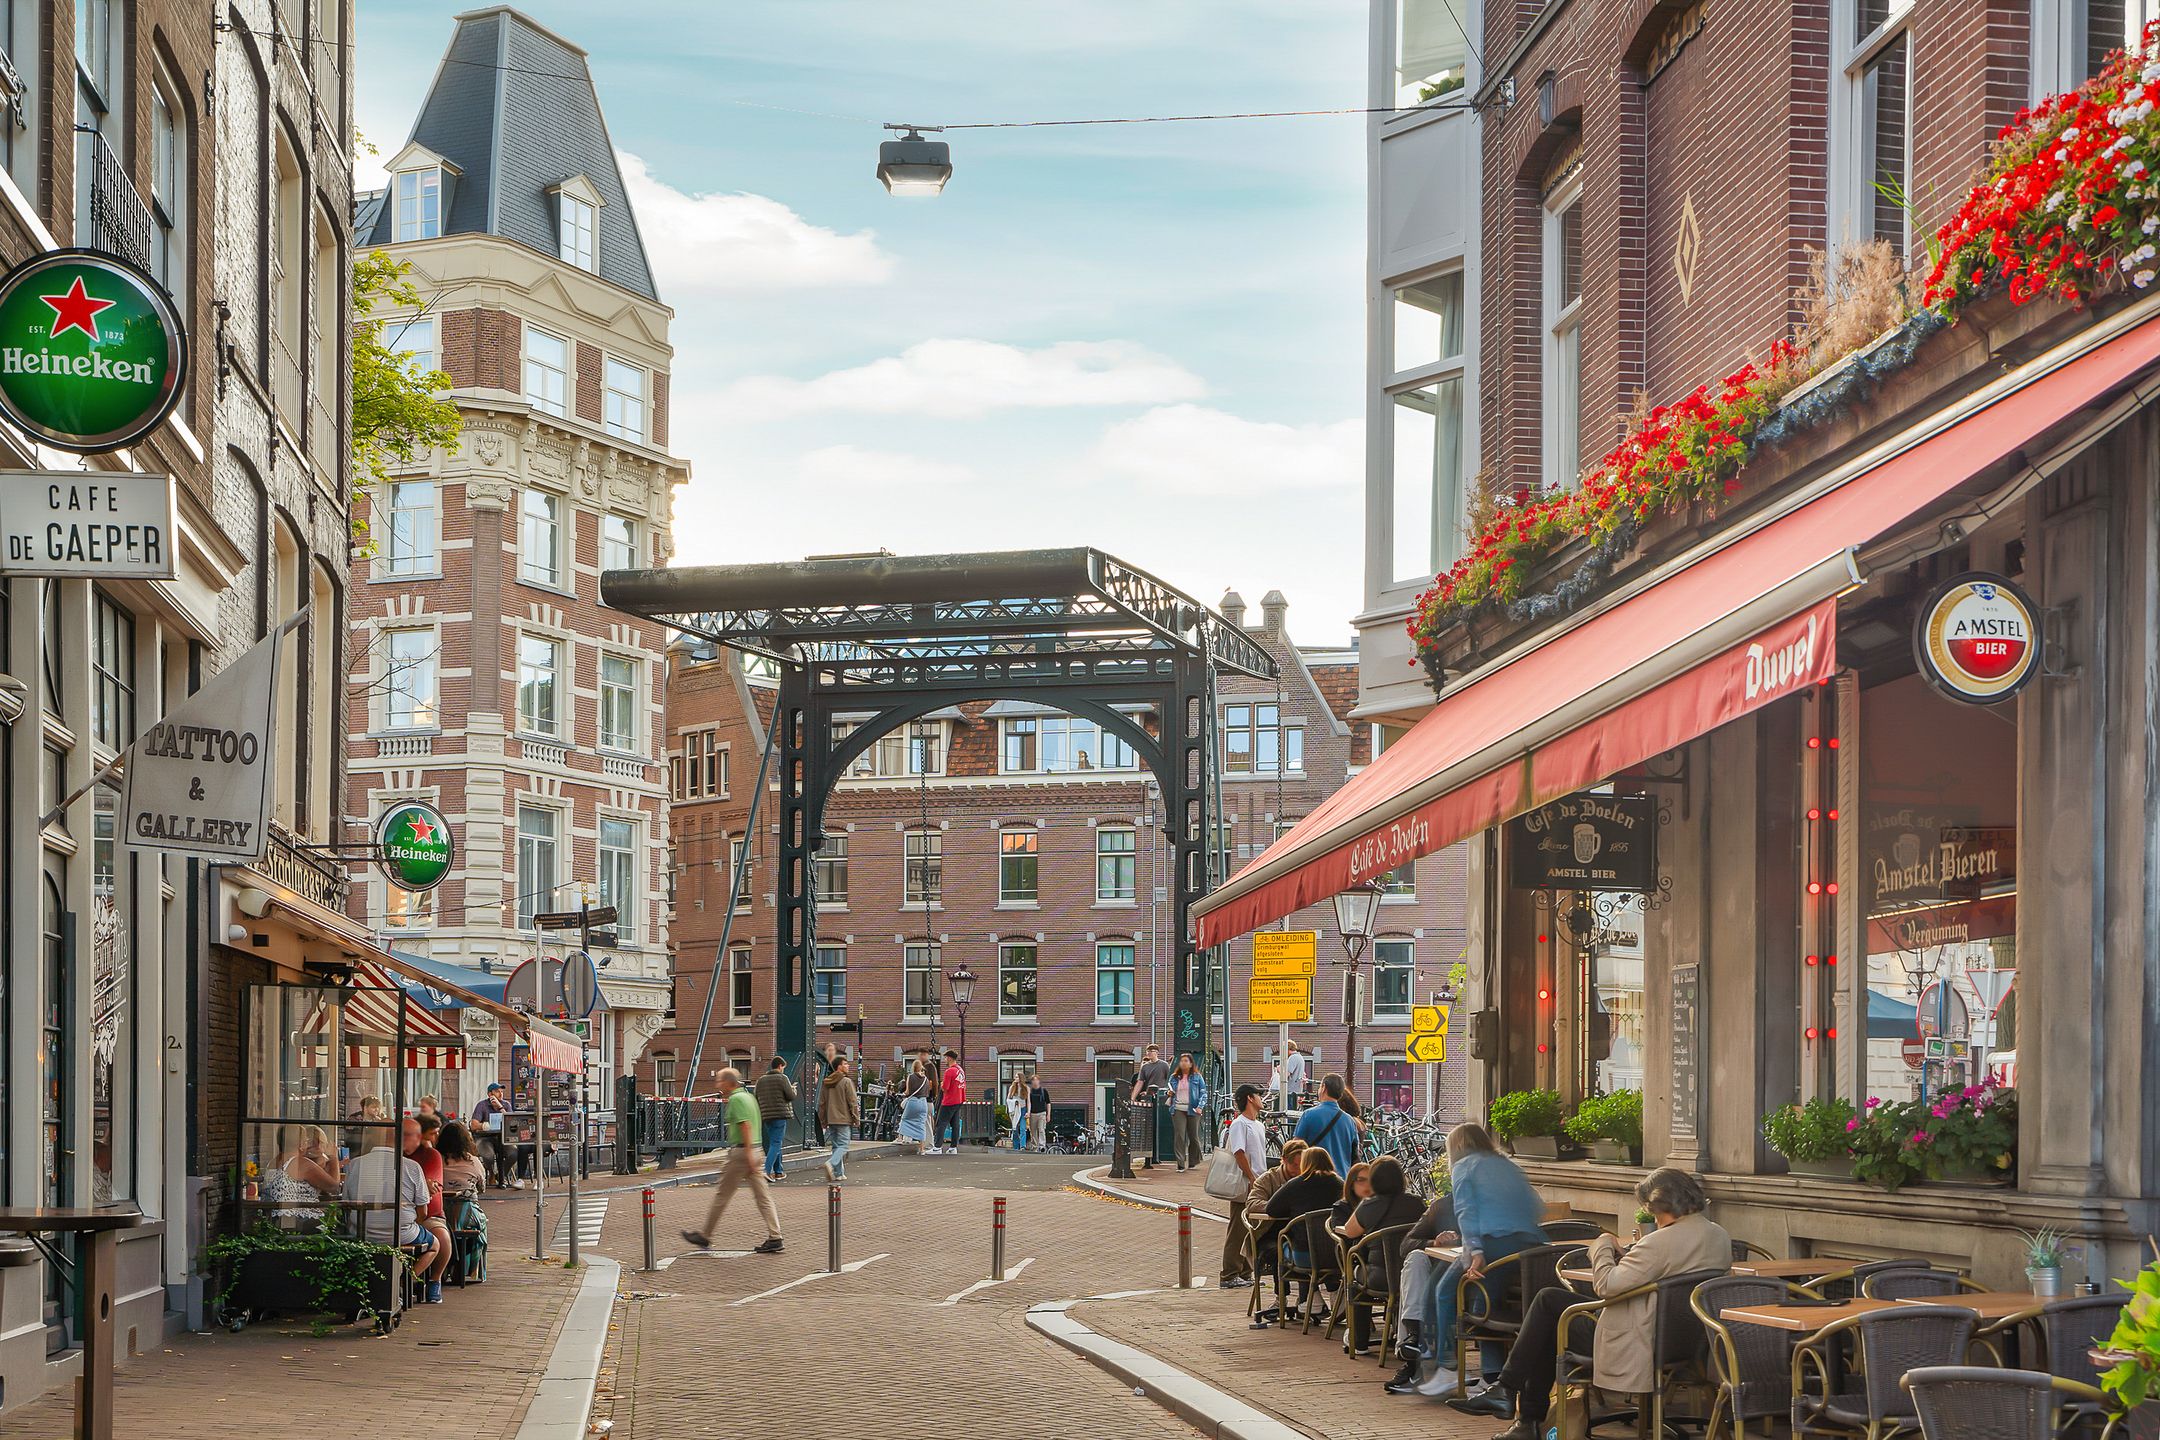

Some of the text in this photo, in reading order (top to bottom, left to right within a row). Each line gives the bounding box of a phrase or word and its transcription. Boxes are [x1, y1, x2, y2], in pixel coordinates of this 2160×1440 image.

[28, 325, 46, 334] EST.
[105, 331, 124, 341] 1873
[3, 347, 154, 384] Heineken
[48, 484, 118, 512] CAFE
[9, 522, 161, 564] DE GAEPER
[1954, 619, 2023, 637] AMSTEL
[1745, 613, 1816, 701] Duvel
[1975, 642, 2007, 655] BIER
[144, 723, 258, 765] TATTOO
[188, 776, 205, 801] &
[1579, 798, 1634, 829] Doelen
[135, 812, 252, 847] GALLERY
[390, 845, 447, 863] Heineken
[1350, 815, 1429, 882] Café de Doelen
[1547, 867, 1616, 879] AMSTEL BIER
[1874, 842, 1998, 900] Amstel Bieren
[1271, 934, 1309, 942] OMLEIDING
[1906, 916, 1968, 948] Vergunning
[167, 1035, 182, 1049] 2A
